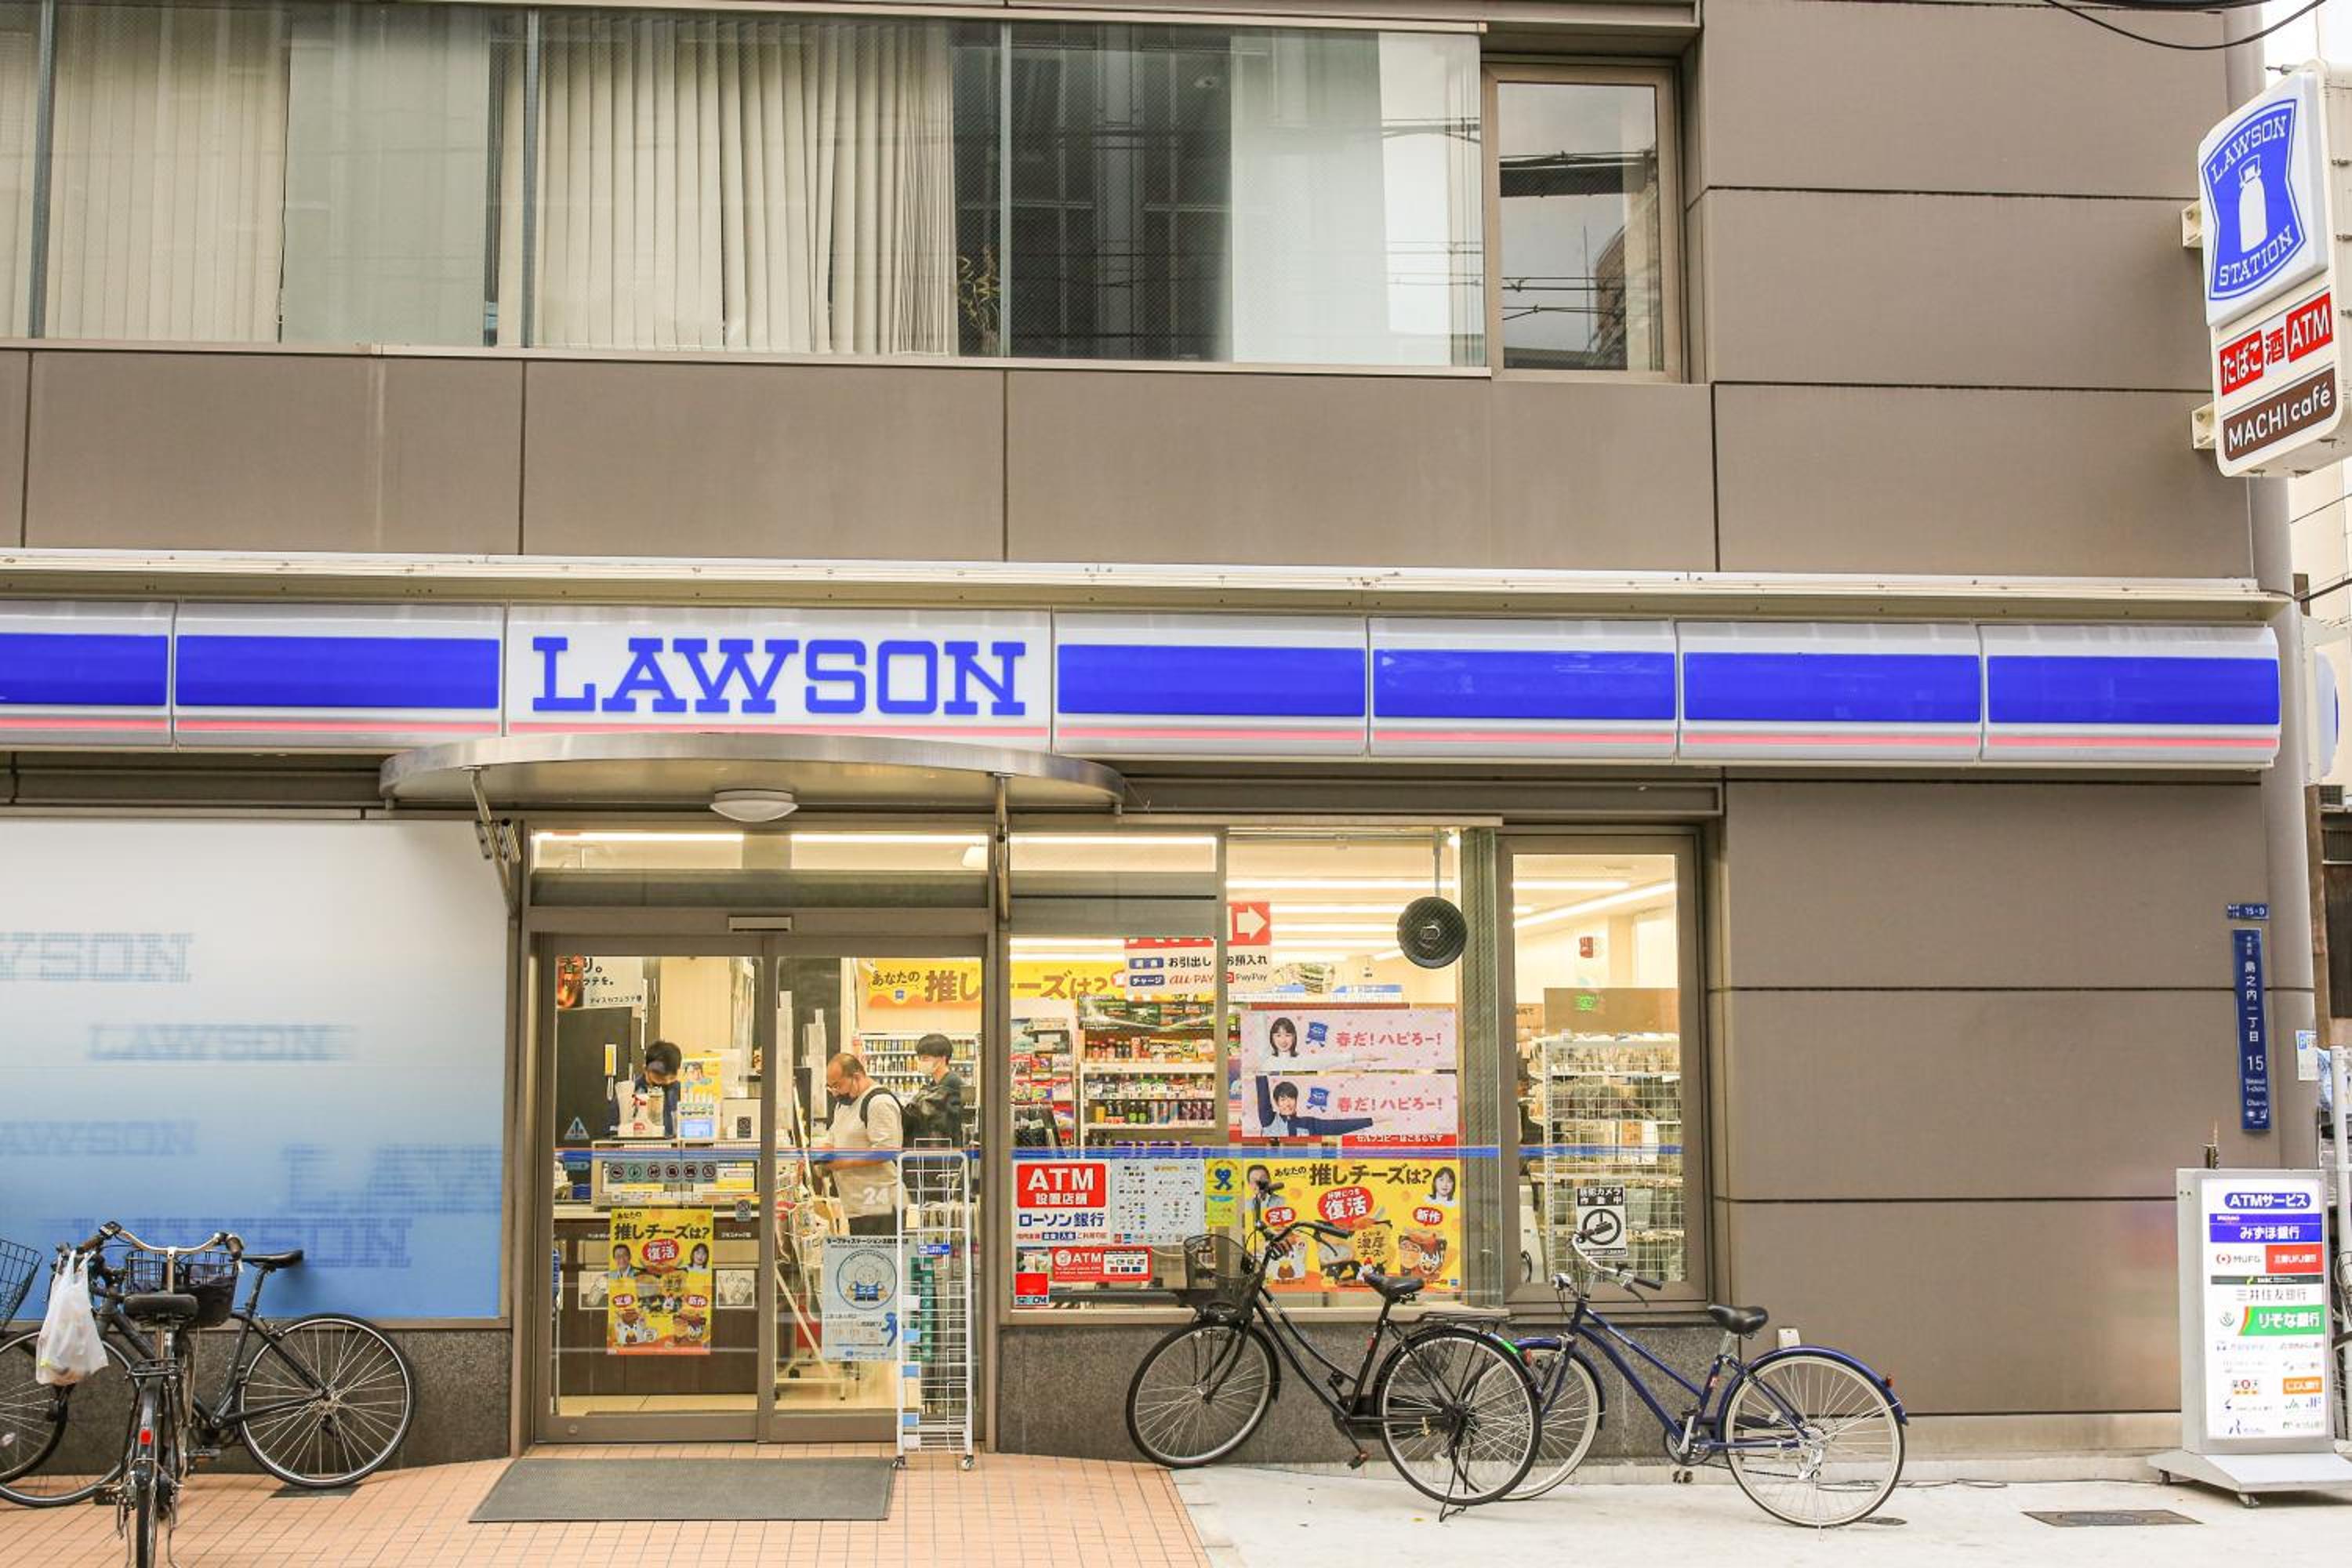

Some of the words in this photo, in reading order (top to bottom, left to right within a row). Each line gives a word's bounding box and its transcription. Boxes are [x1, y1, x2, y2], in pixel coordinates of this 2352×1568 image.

[2211, 115, 2287, 184] LAWSON
[2220, 225, 2293, 287] STATION
[2223, 342, 2261, 387] たばこ
[2265, 328, 2285, 365] 酒
[2289, 303, 2330, 354] ATM
[2228, 402, 2288, 452] MACHI
[2290, 382, 2331, 422] café
[532, 637, 1026, 716] LAWSON
[1168, 956, 1212, 968] お引出し
[871, 971, 921, 986] あなたの
[88, 1023, 345, 1061] LAWSON
[2247, 1055, 2263, 1072] 15
[1027, 1167, 1094, 1191] ATM
[1274, 1166, 1307, 1177] あなたの
[1308, 1163, 1432, 1186] 推しチーズは?
[1325, 1196, 1367, 1221] 復活
[2229, 1194, 2308, 1207] ATMサービス
[1018, 1212, 1105, 1227] ローソン銀行
[1416, 1208, 1441, 1224] 新作
[614, 1222, 710, 1240] 推しチーズは?
[2240, 1226, 2299, 1240] みずほ銀行
[1073, 1253, 1102, 1263] ATM
[2258, 1312, 2321, 1328] りそな銀行
